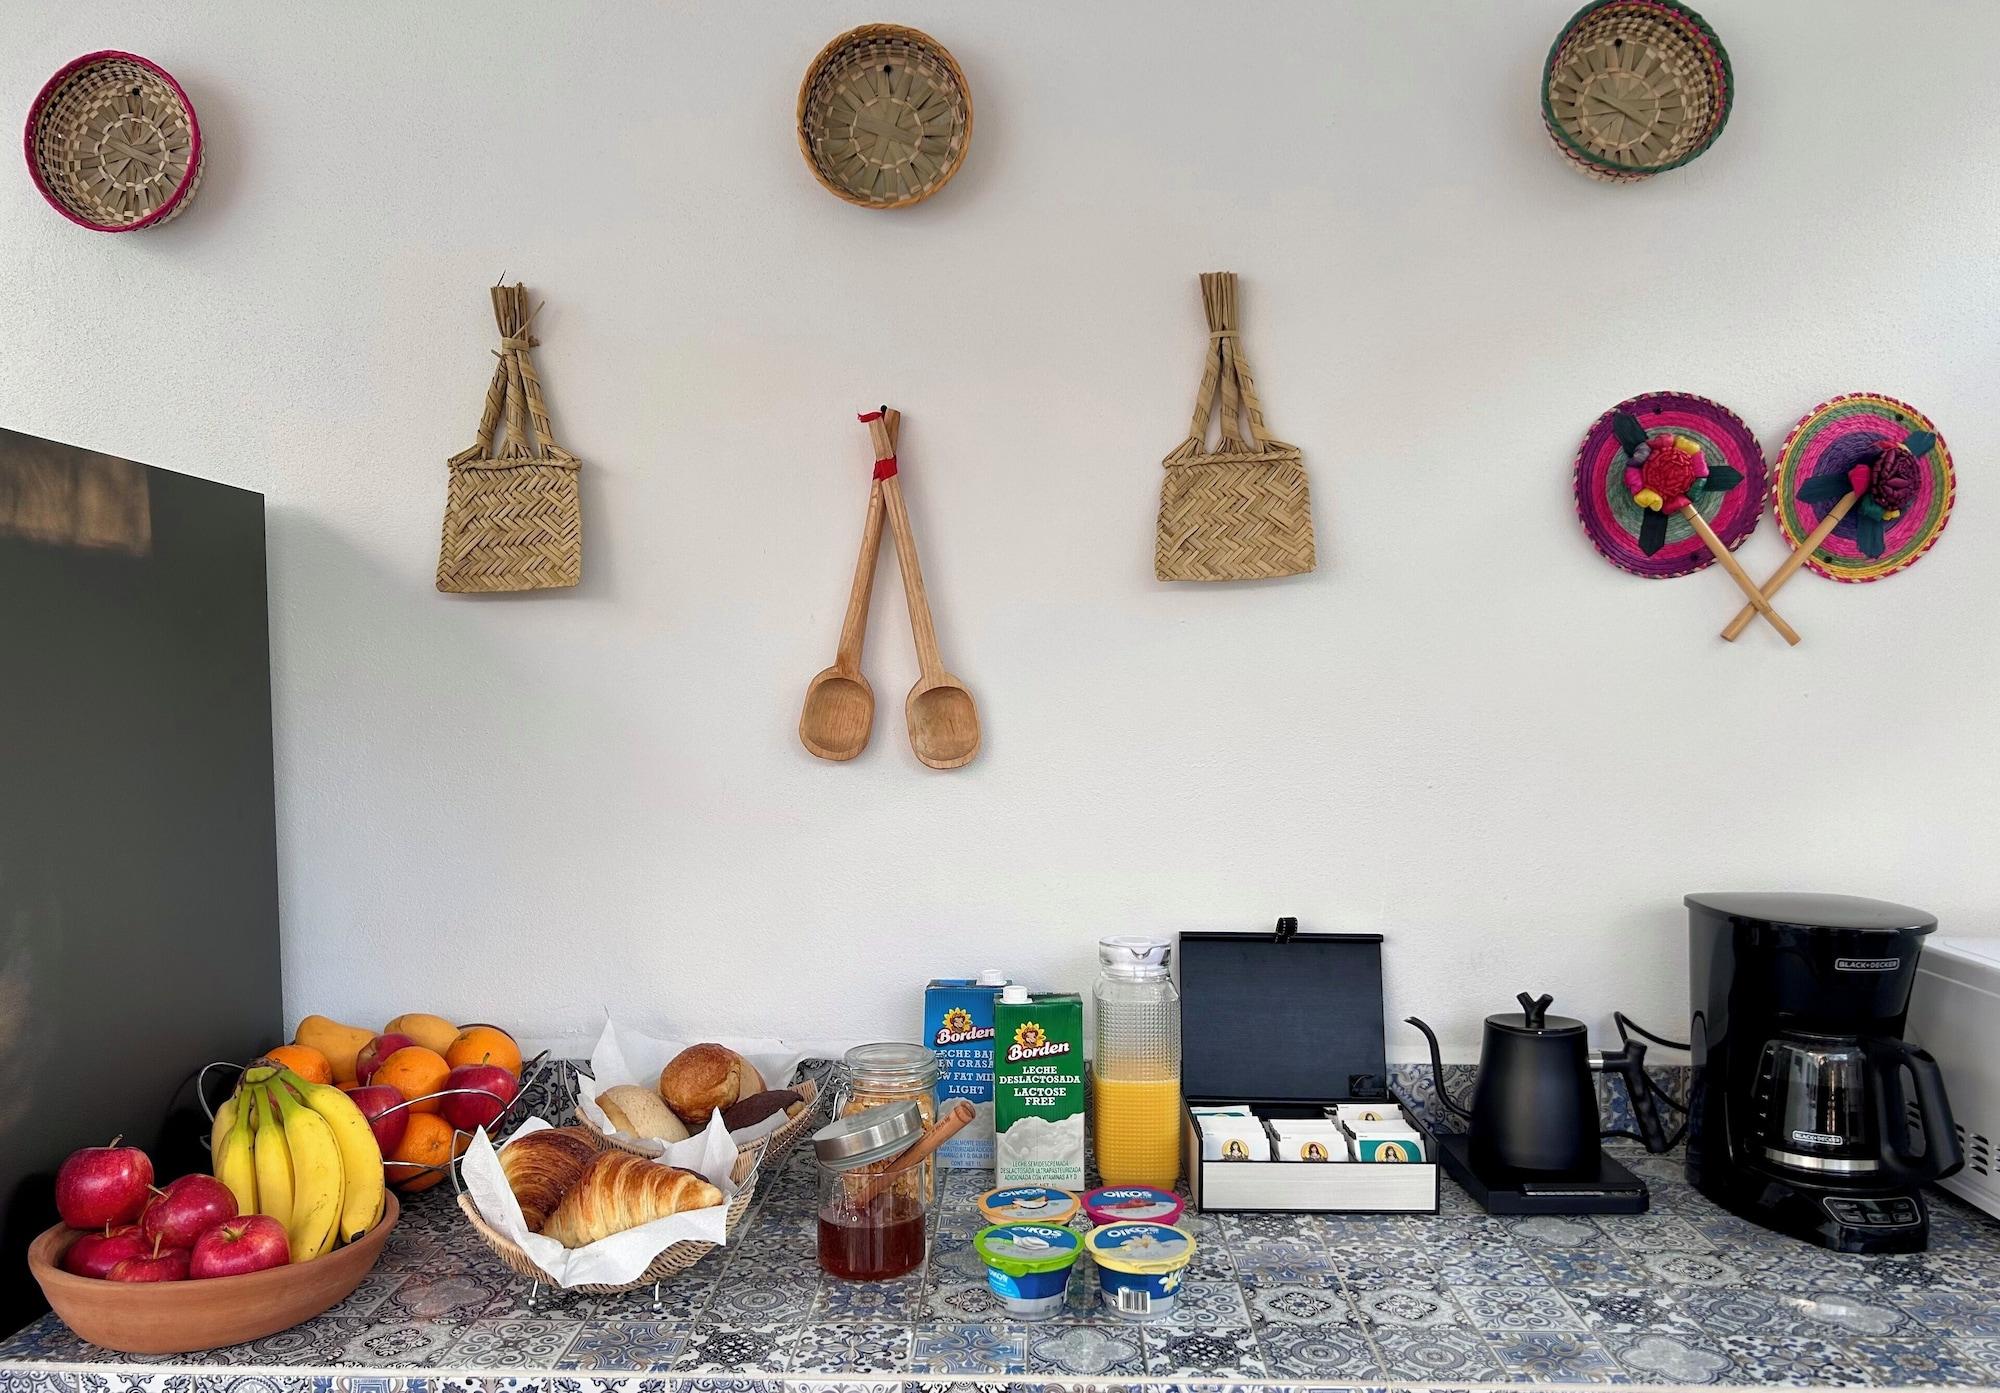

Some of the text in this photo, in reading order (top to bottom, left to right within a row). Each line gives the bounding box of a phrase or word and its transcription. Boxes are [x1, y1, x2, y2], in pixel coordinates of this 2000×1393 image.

[1838, 961, 1897, 969] BLACK+DECKER
[936, 1027, 994, 1045] Borden
[1008, 1042, 1070, 1062] Borden
[938, 1060, 954, 1068] EN
[1022, 1066, 1058, 1075] LECHE
[953, 1072, 973, 1080] FAT
[999, 1075, 1081, 1084] DESLACTOSADA
[948, 1085, 985, 1095] LIGHT
[1013, 1087, 1067, 1097] LACTOSE
[1024, 1096, 1056, 1106] FREE
[1794, 1132, 1841, 1143] BLACK+DECKER
[998, 1188, 1047, 1198] OIKOS
[1102, 1190, 1152, 1199] OIKOS
[1107, 1226, 1159, 1238] OIKOS
